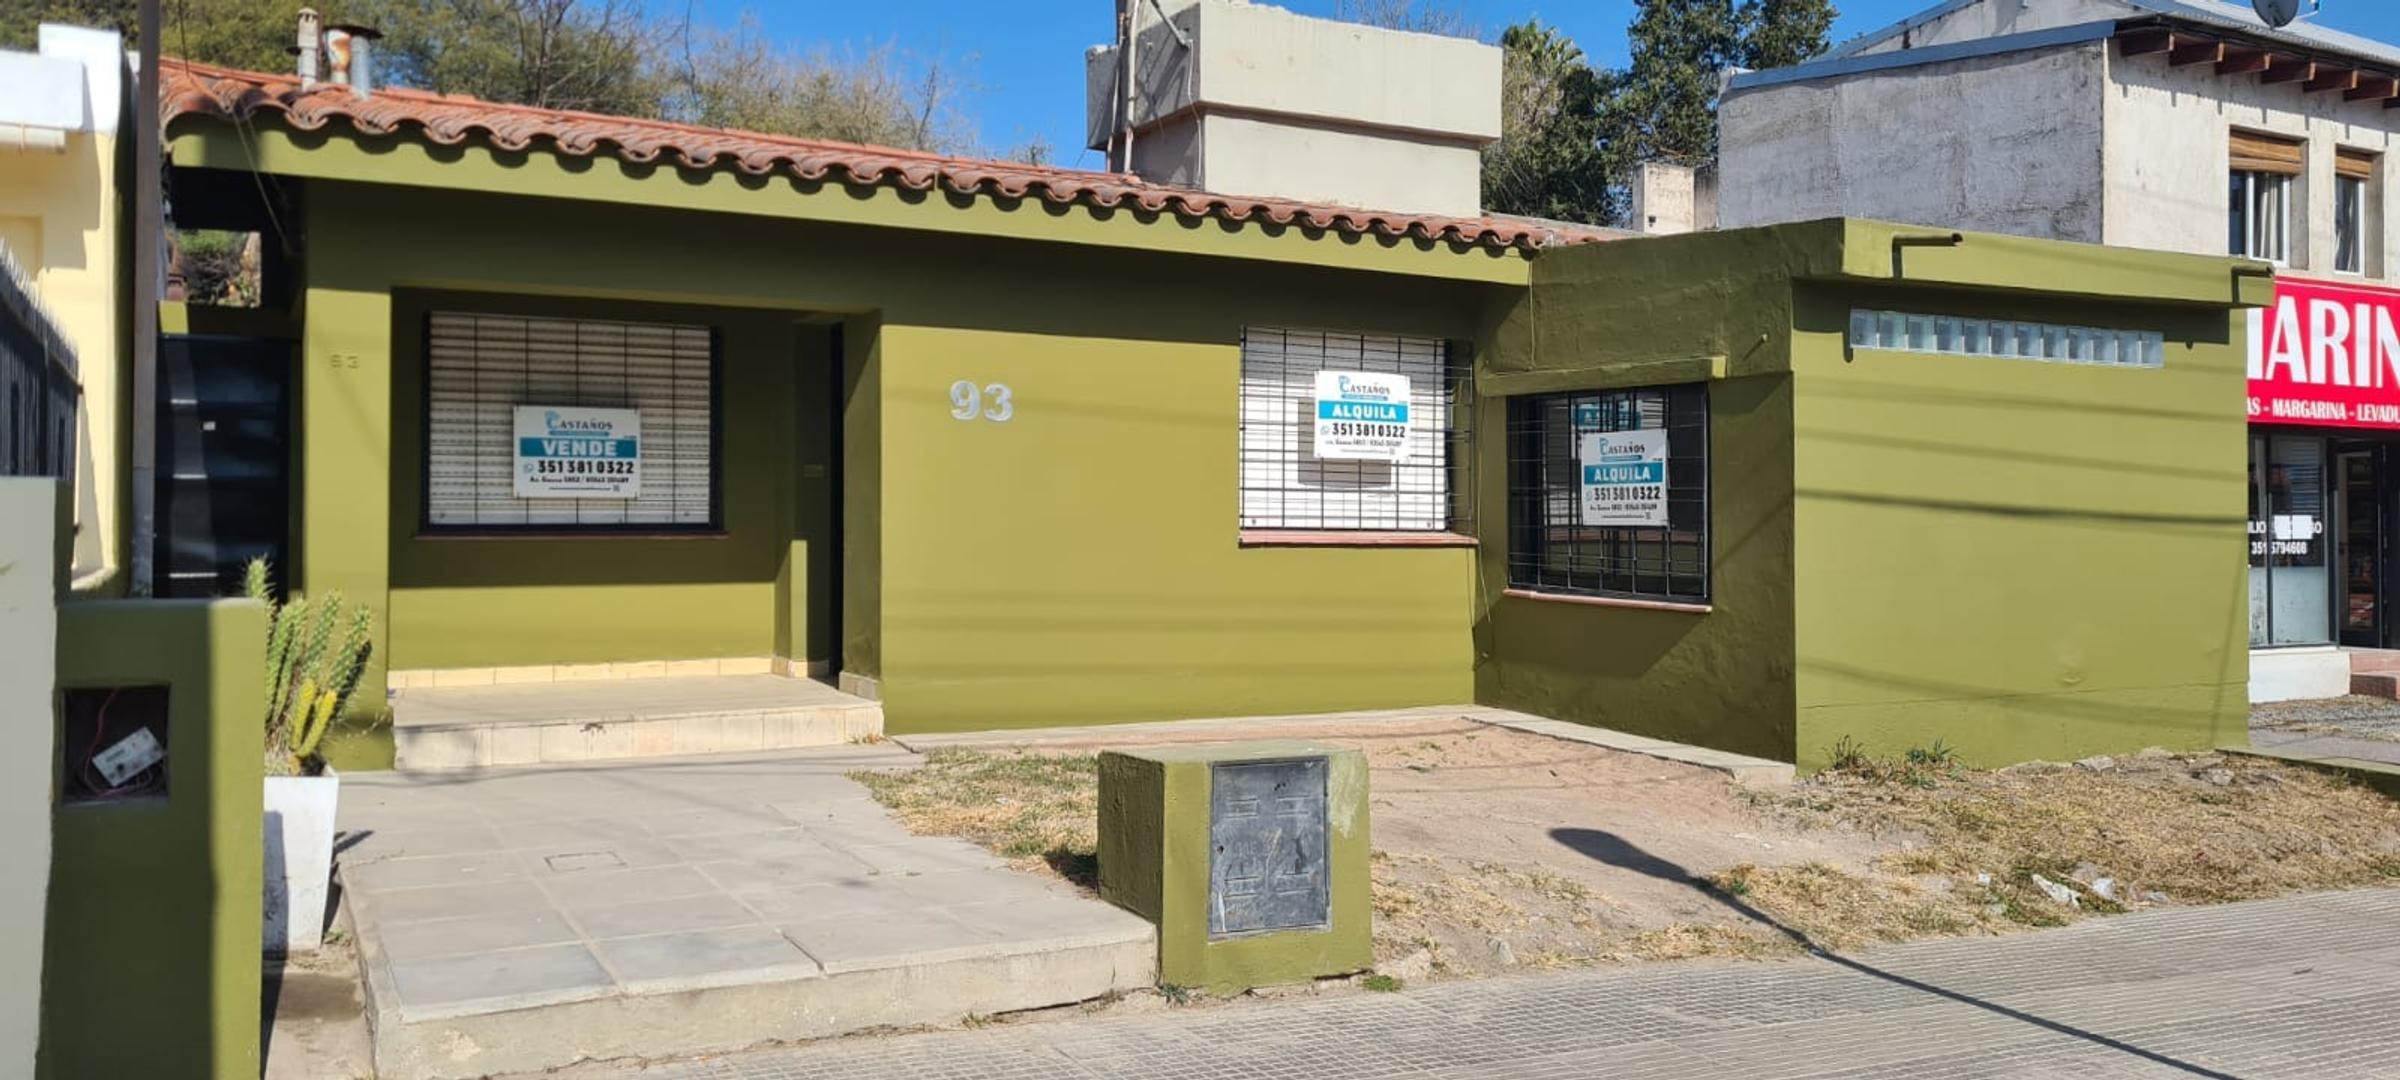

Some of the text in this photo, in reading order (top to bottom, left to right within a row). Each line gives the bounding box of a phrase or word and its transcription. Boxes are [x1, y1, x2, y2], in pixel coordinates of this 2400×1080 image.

[950, 380, 1013, 422] 93
[1332, 404, 1397, 420] ALQUILA
[2272, 398, 2347, 421] MARGARINA
[542, 440, 618, 456] VENDE
[1594, 467, 1651, 482] ALQUILA
